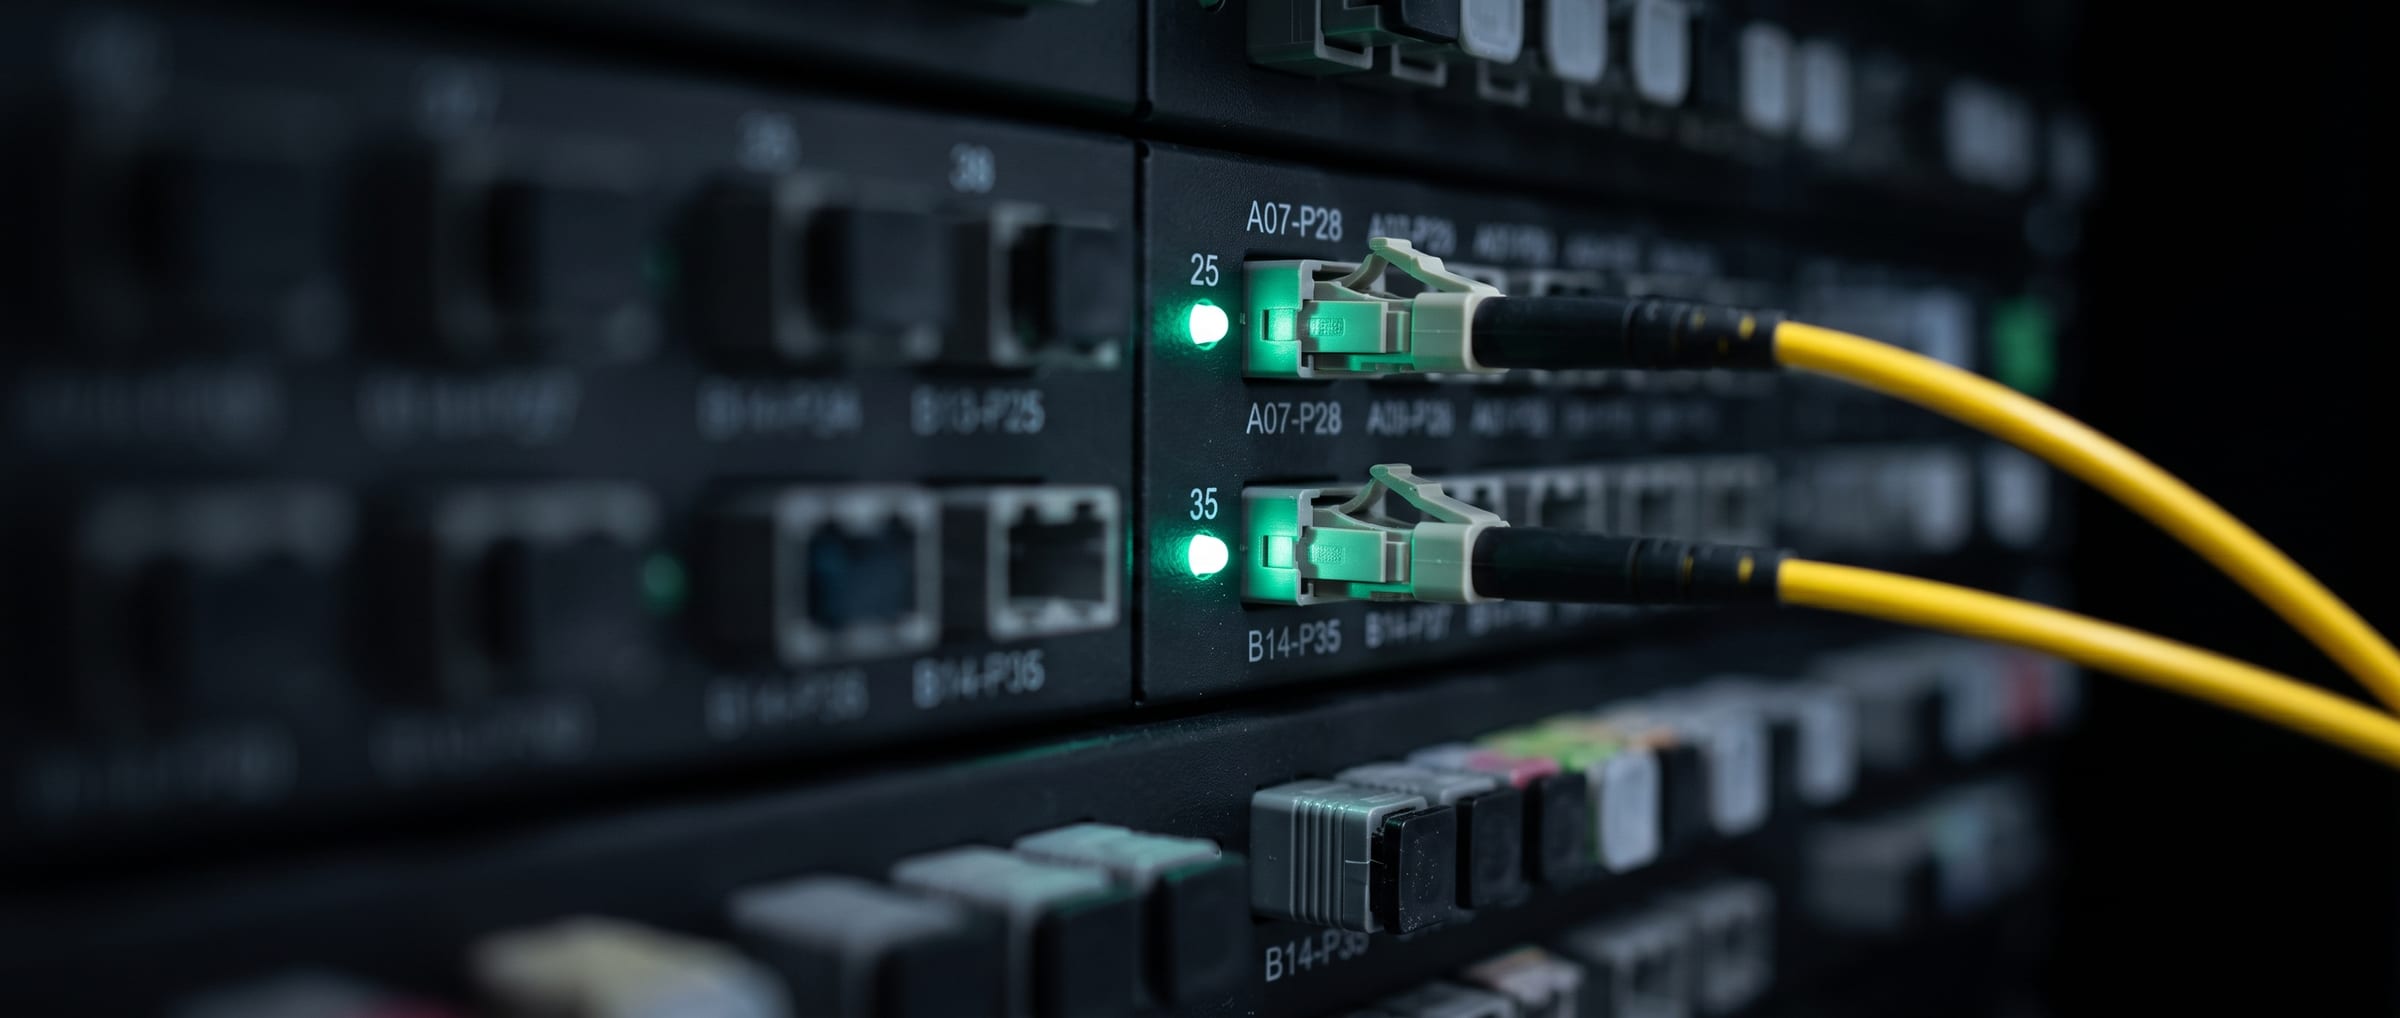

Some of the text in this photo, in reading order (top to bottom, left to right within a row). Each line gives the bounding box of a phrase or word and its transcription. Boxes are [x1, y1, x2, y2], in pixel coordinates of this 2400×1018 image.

[1246, 200, 1344, 242] A07-P28
[1190, 254, 1219, 286] 25
[1246, 402, 1343, 436] A07-P28
[1189, 488, 1218, 520] 35
[1249, 618, 1342, 662] B14-P35
